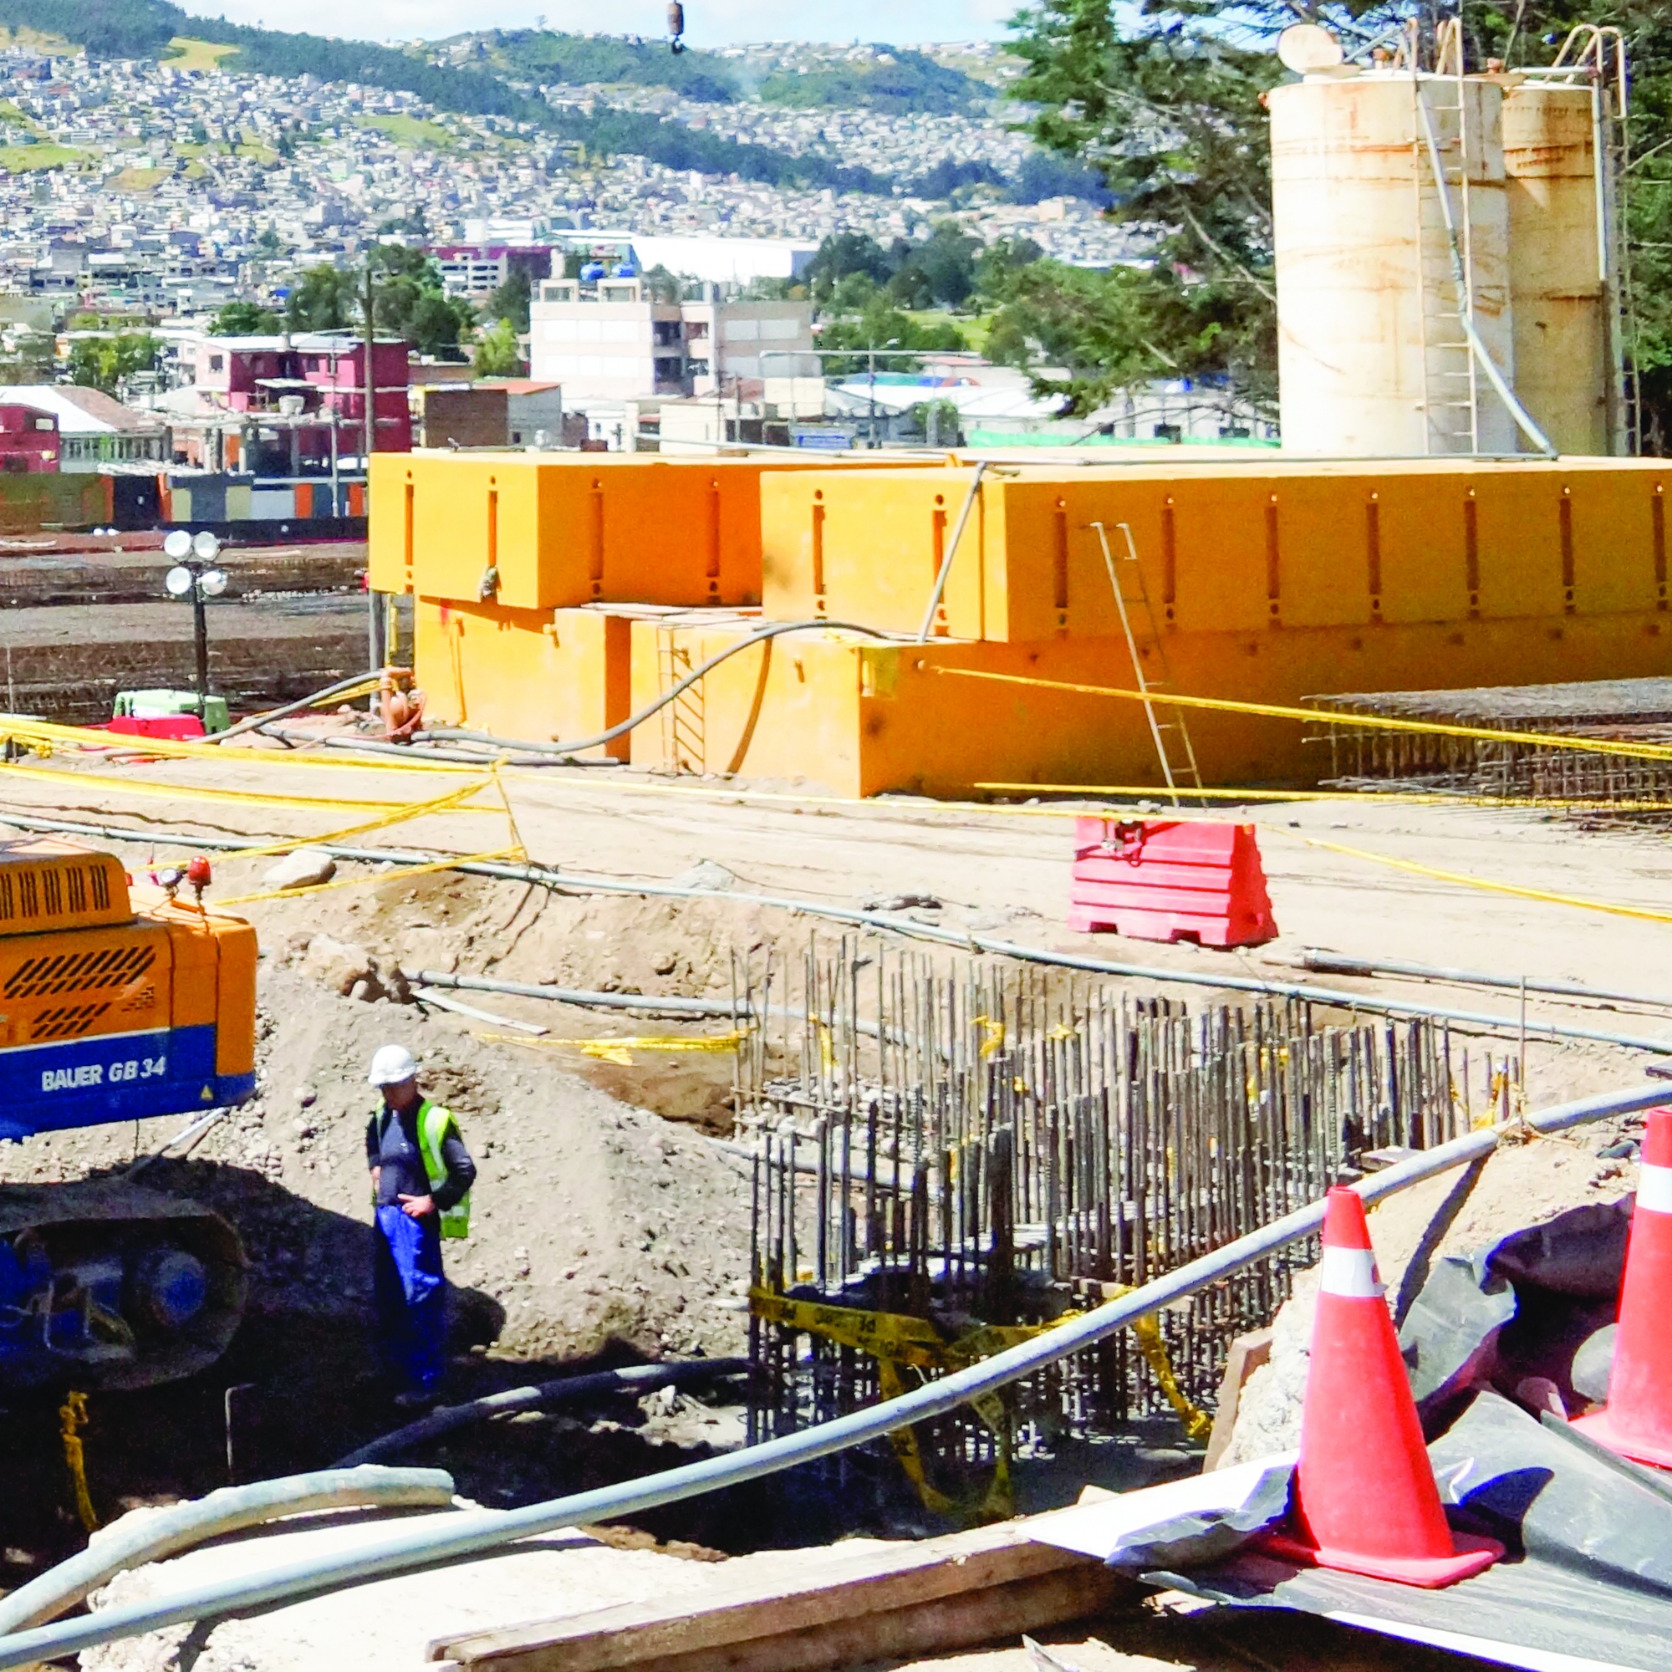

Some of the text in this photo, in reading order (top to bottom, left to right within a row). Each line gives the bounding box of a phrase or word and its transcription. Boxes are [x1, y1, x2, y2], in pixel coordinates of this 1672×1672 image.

[42, 1056, 166, 1091] BAUER GB 34
